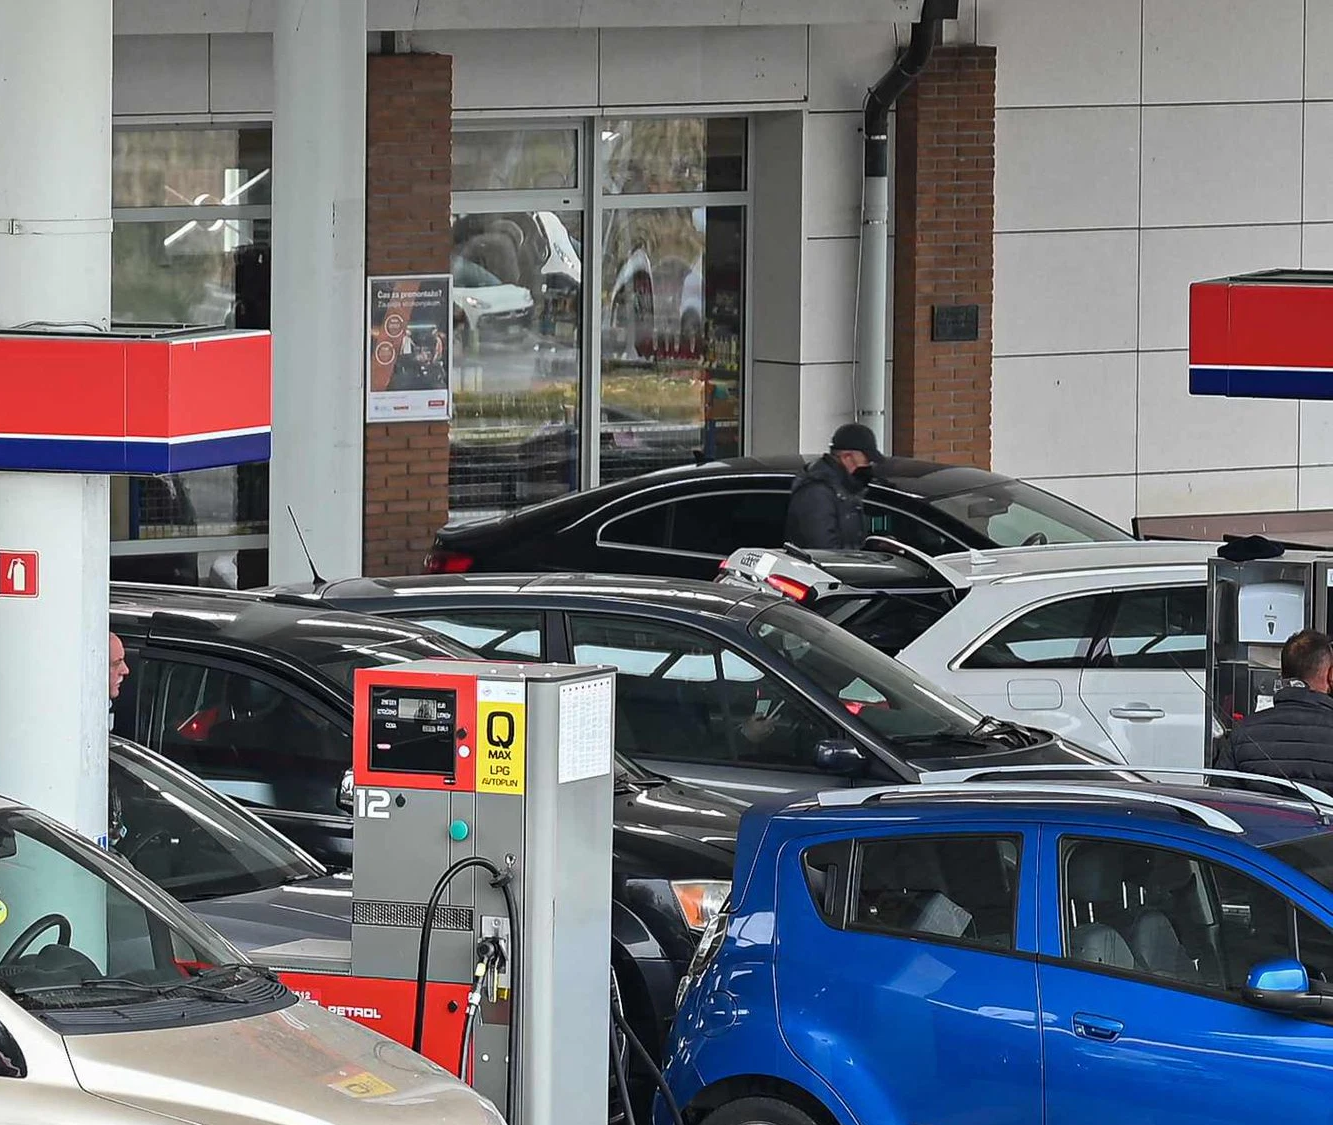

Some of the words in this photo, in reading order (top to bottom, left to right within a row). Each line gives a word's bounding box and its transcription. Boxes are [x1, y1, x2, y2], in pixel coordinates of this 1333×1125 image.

[486, 711, 515, 749] Q
[488, 750, 512, 761] MAX
[489, 764, 511, 776] LPG
[356, 789, 391, 819] 12
